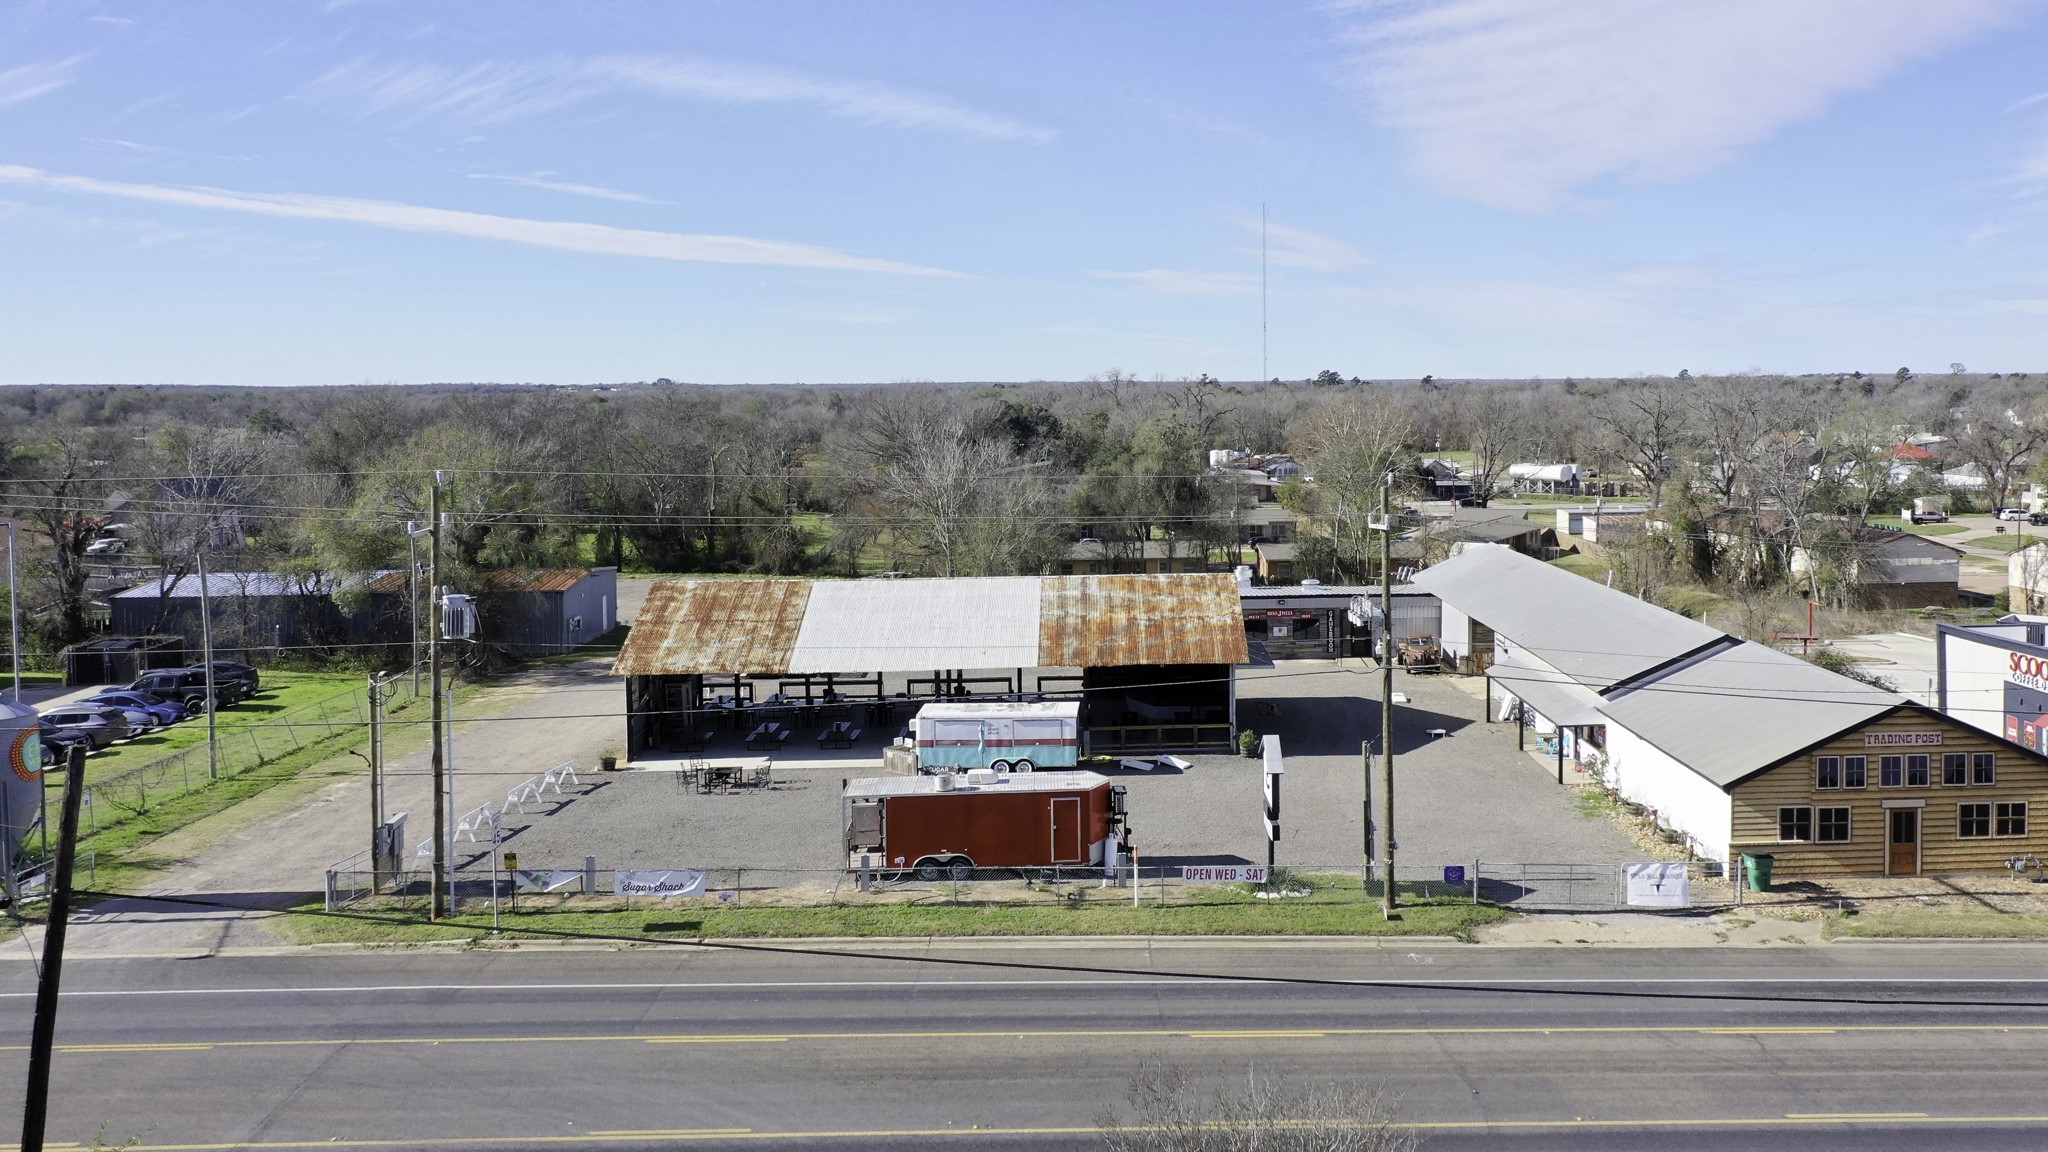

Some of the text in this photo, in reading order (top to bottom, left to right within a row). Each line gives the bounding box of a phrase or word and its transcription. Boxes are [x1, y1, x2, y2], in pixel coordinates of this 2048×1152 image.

[1865, 733, 1941, 745] TRADING POST
[1186, 868, 1212, 880] OPEN
[1215, 868, 1237, 880] WED
[1245, 868, 1264, 881] SAT
[622, 881, 685, 894] Sugar Shack
